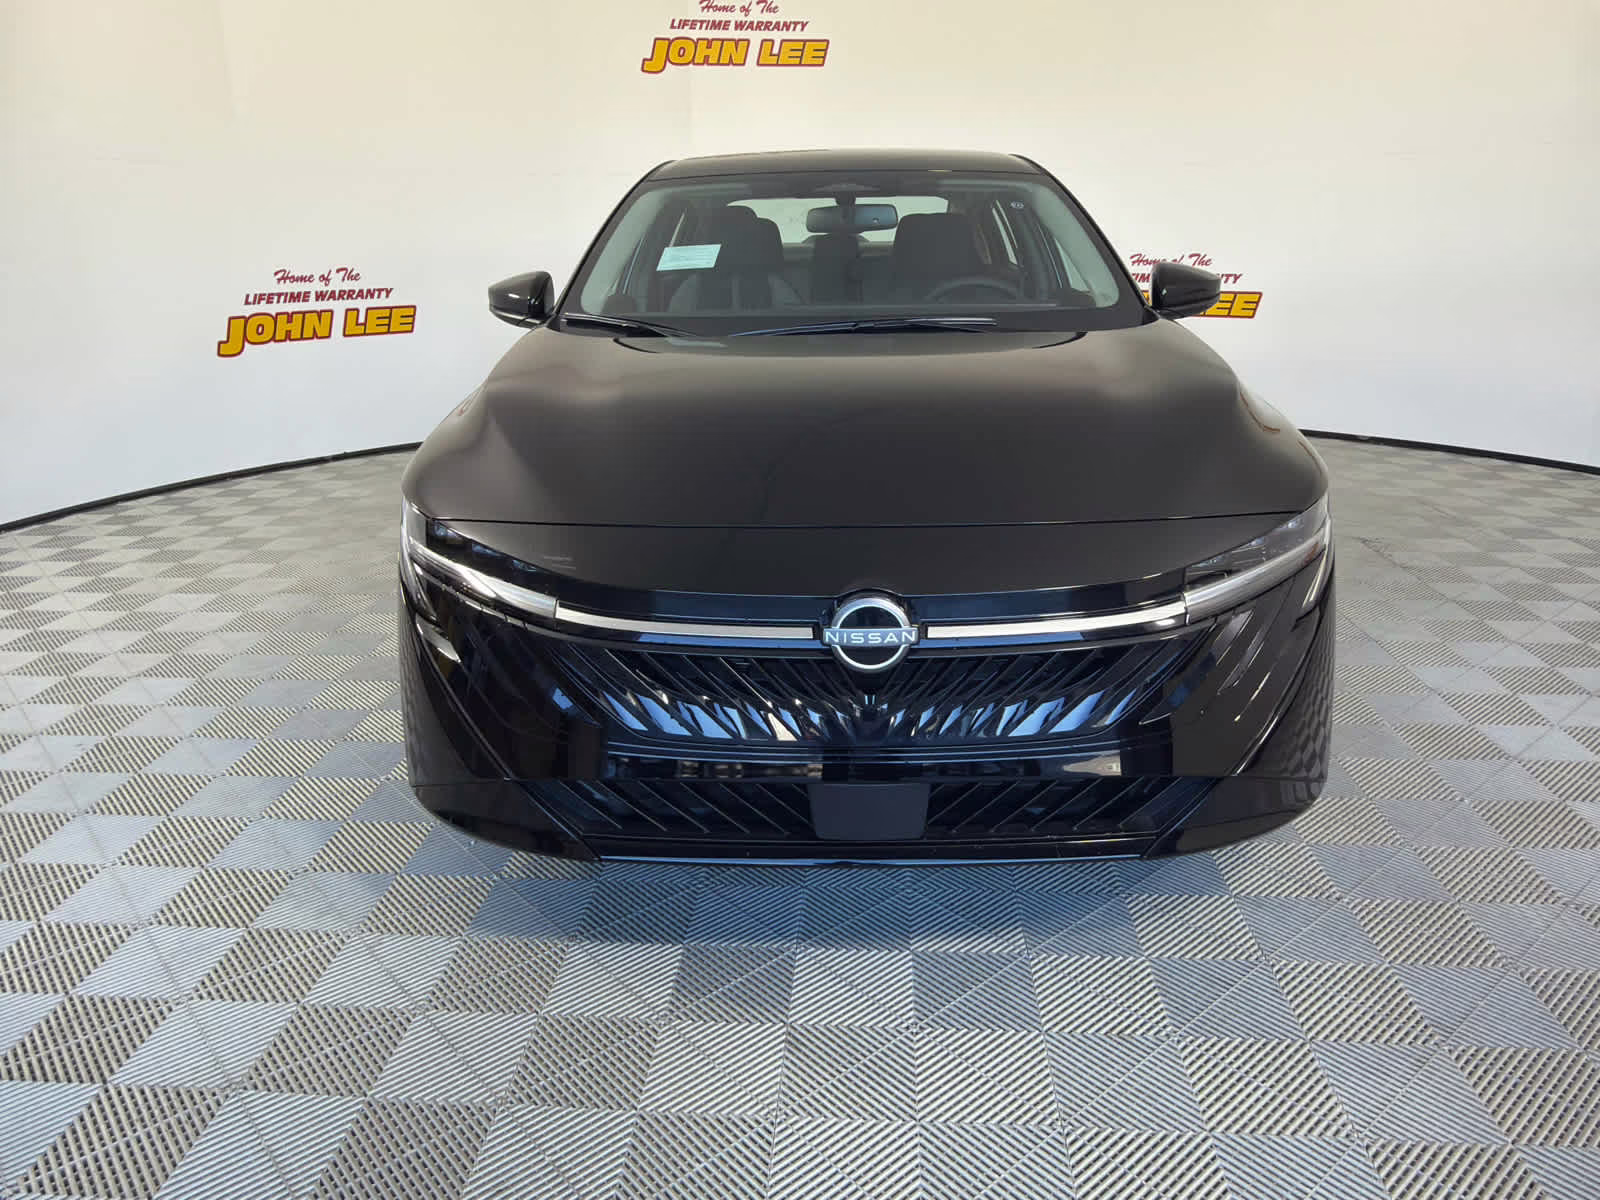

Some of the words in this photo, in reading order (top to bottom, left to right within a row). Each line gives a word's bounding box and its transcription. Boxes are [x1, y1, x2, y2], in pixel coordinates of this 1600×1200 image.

[698, 0, 736, 13] Home
[739, 1, 752, 17] of
[756, 0, 779, 14] The
[669, 19, 731, 31] LIFETIME
[734, 19, 809, 32] WARRANTY
[641, 37, 750, 74] JOHN
[757, 39, 829, 67] LEE
[1129, 253, 1167, 266] Hom
[1188, 253, 1212, 267] The
[273, 269, 315, 285] Home
[318, 270, 331, 286] of
[336, 267, 360, 282] The
[244, 290, 311, 305] LIFETIME
[314, 287, 393, 302] WARRANTY
[1193, 291, 1262, 319] EE
[217, 309, 334, 358] JOHN
[343, 305, 416, 337] LEE
[825, 631, 916, 644] NISSAN
